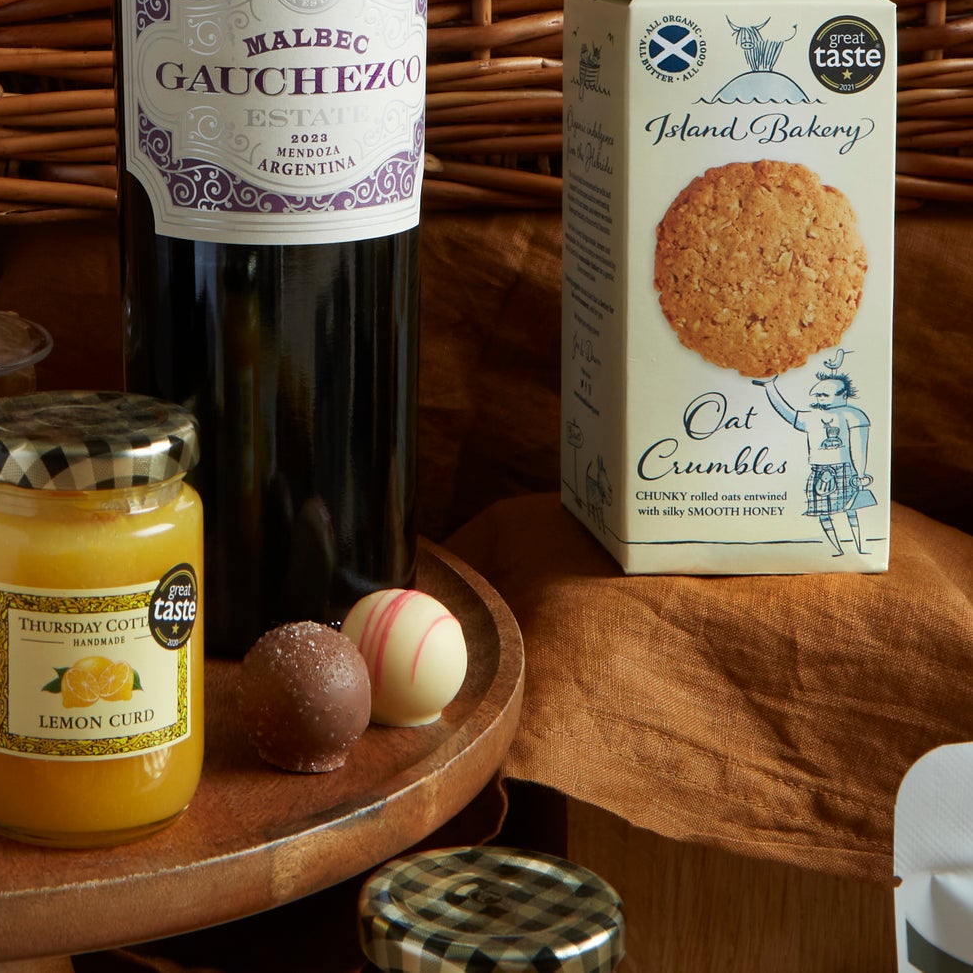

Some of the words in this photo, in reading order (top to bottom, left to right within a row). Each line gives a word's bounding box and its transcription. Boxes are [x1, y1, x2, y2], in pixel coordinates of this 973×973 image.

[646, 20, 661, 35] ALL
[662, 15, 702, 34] ORGANIC
[242, 27, 370, 58] MALBEC
[639, 39, 647, 58] ALL
[829, 32, 865, 49] great
[683, 68, 699, 82] ALL
[697, 40, 707, 67] GOOD
[813, 46, 882, 68] taste
[155, 55, 421, 97] GAUCHEZCO
[641, 59, 674, 83] BUTTER
[839, 83, 855, 91] 2021
[243, 106, 370, 128] ESTATE
[291, 133, 328, 144] 2023
[645, 113, 749, 146] Island
[749, 112, 875, 155] Bakery
[276, 145, 340, 158] MENDOZA
[257, 155, 357, 176] ARGENTINA
[683, 392, 758, 440] Oat
[637, 438, 788, 482] Crumbles
[635, 491, 688, 502] CHUNKY
[690, 491, 718, 501] rolled
[721, 492, 741, 501] oats
[744, 491, 787, 501] entwined
[638, 507, 660, 516] with
[663, 506, 685, 518] silky
[687, 507, 740, 516] SMOOTH
[742, 507, 785, 516] HONEY
[168, 584, 192, 600] great
[154, 597, 196, 622] taste
[19, 616, 102, 634] THURSDAY
[73, 636, 125, 647] HANDMADE
[39, 715, 103, 730] LEMON
[109, 708, 155, 727] CURD
